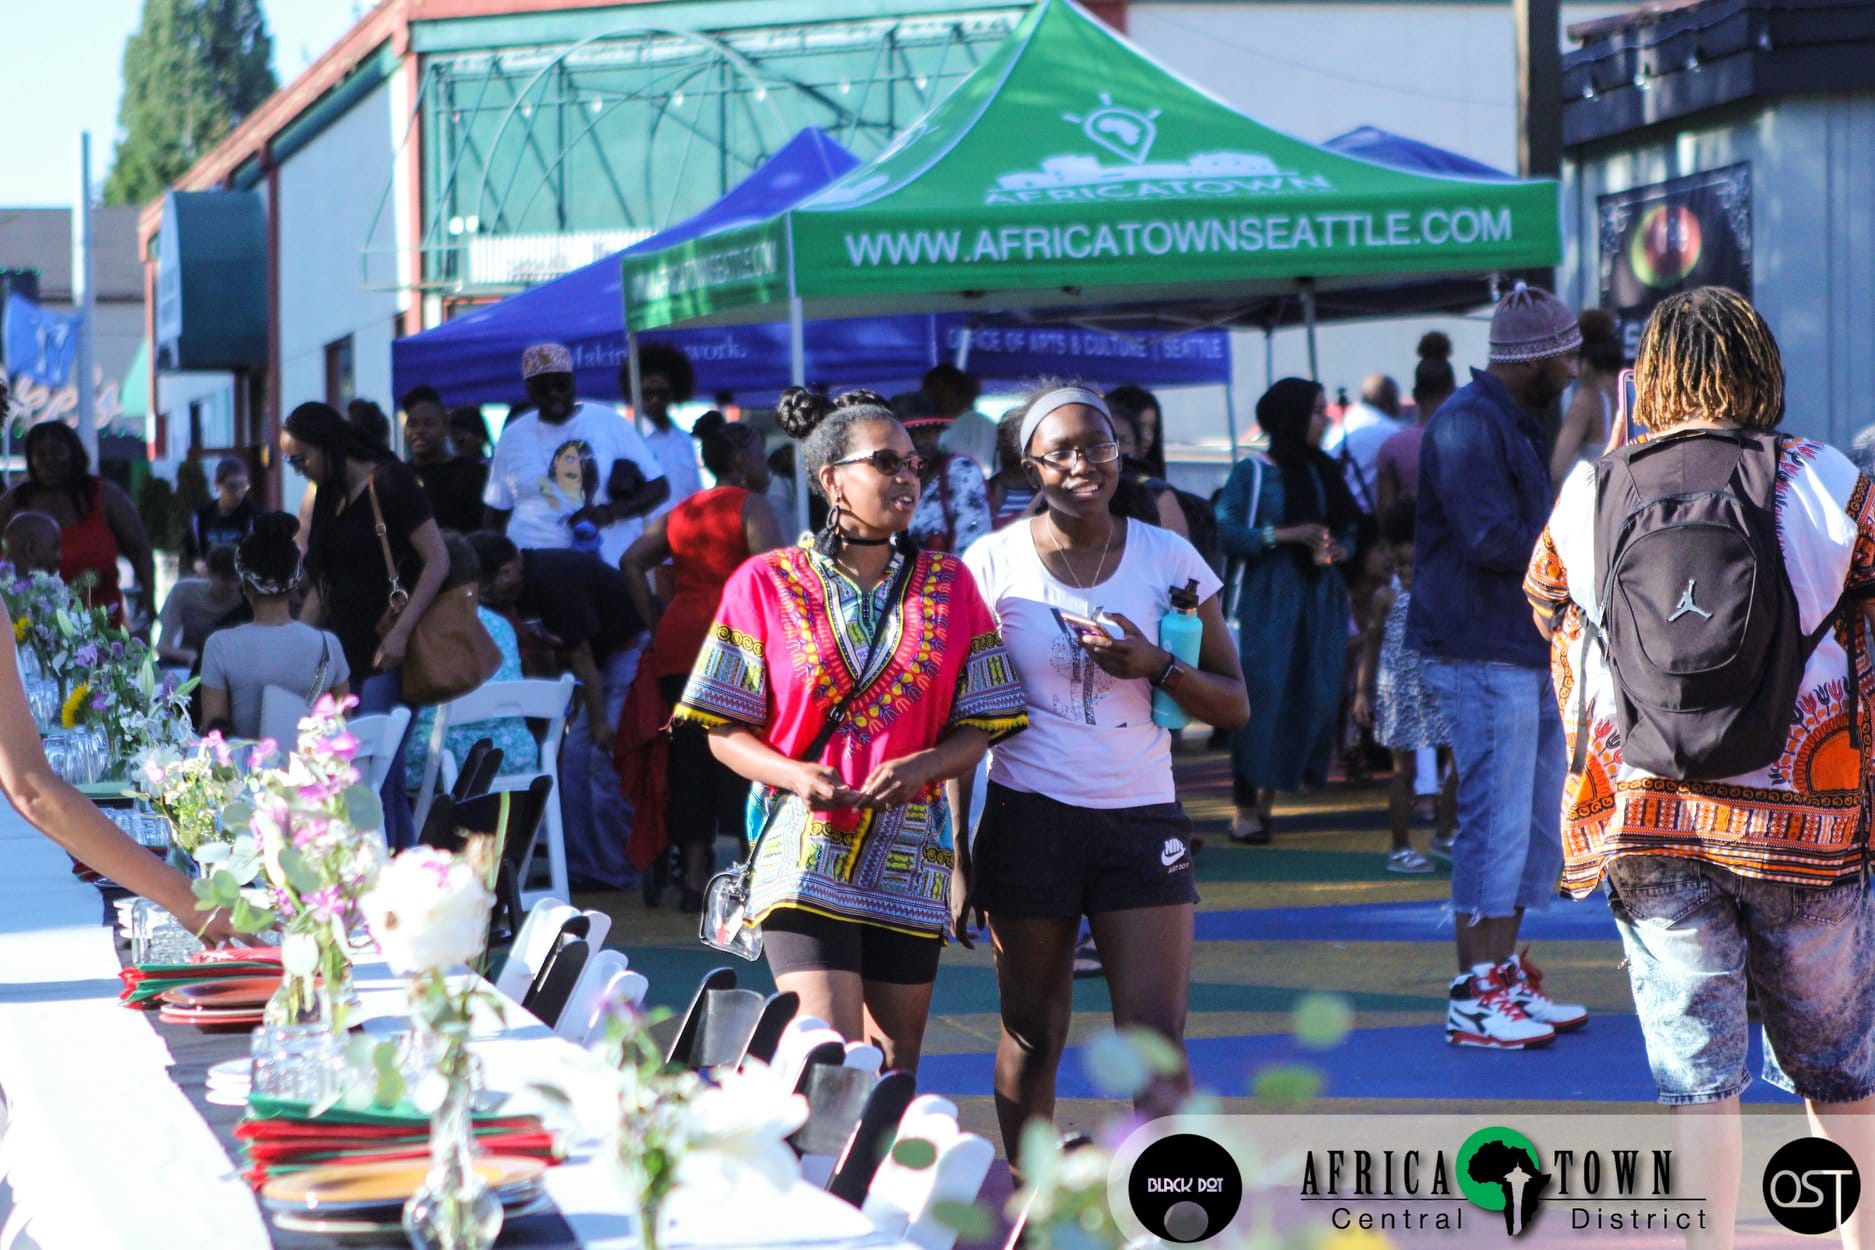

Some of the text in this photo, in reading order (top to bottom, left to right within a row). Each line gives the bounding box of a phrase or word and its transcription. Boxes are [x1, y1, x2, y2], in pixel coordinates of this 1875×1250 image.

[983, 174, 1333, 206] AFRICATOWN
[845, 208, 1513, 266] WWW.AFRICATOWNSEATTLE.COM
[573, 334, 747, 369] akin work.
[946, 328, 1001, 352] OICE
[1162, 336, 1224, 360] SEATTLE
[1164, 838, 1184, 855] NIK
